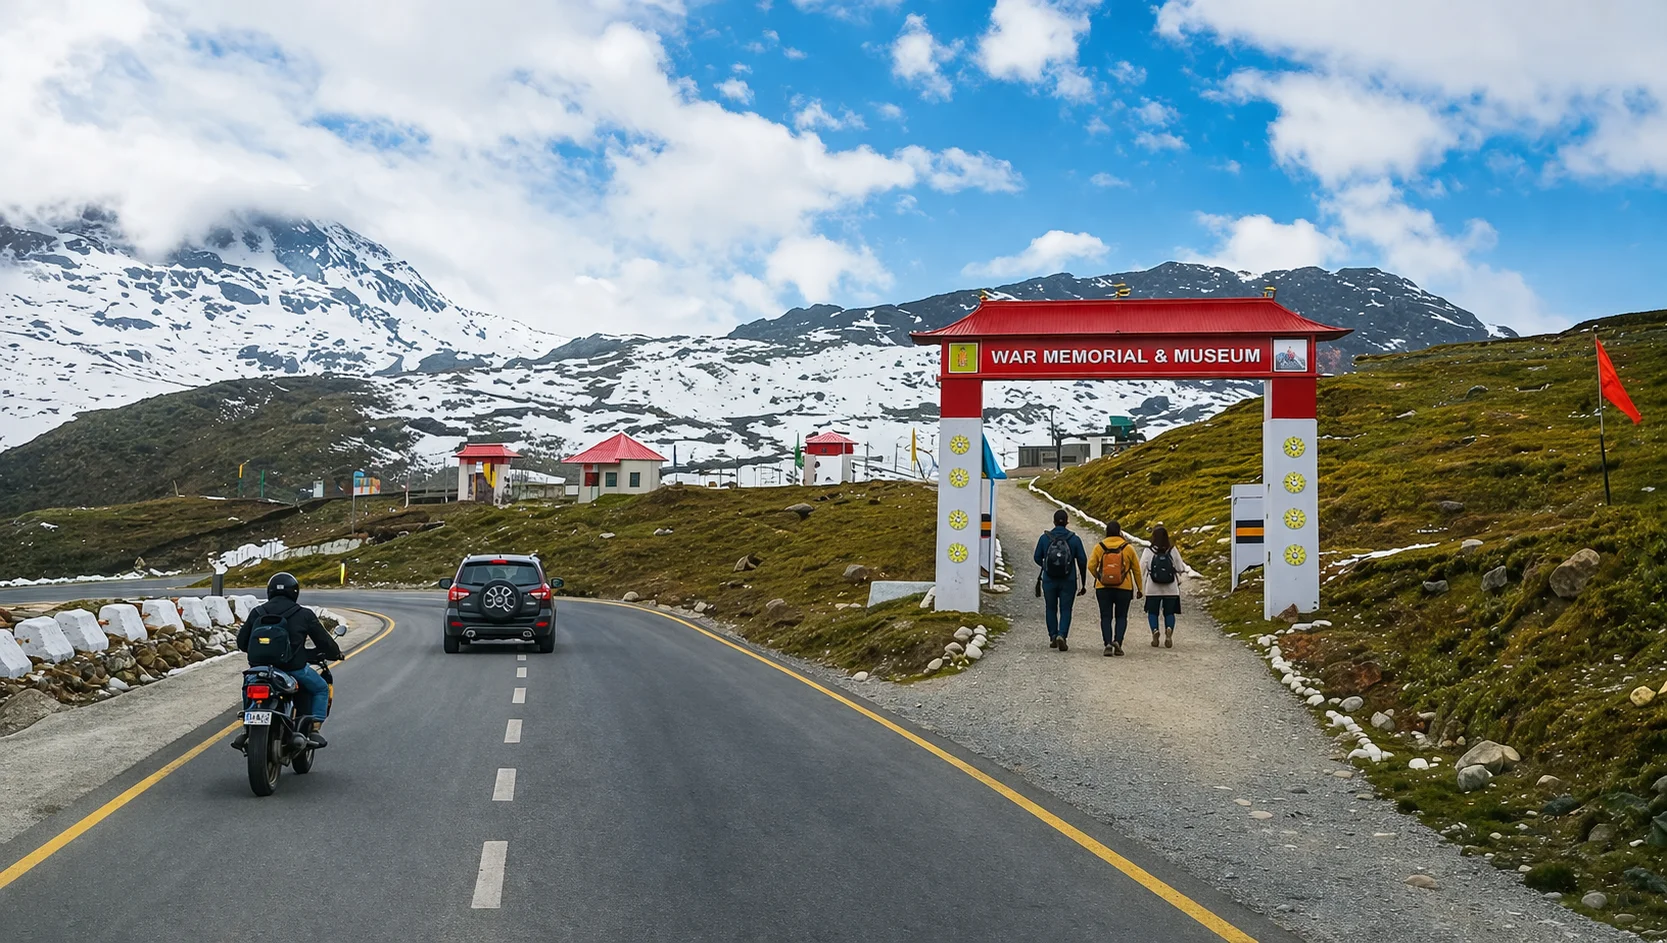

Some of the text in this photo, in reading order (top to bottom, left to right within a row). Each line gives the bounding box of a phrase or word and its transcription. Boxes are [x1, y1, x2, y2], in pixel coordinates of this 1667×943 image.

[991, 349, 1261, 364] WAR MEMORIAL & MUSEUM
